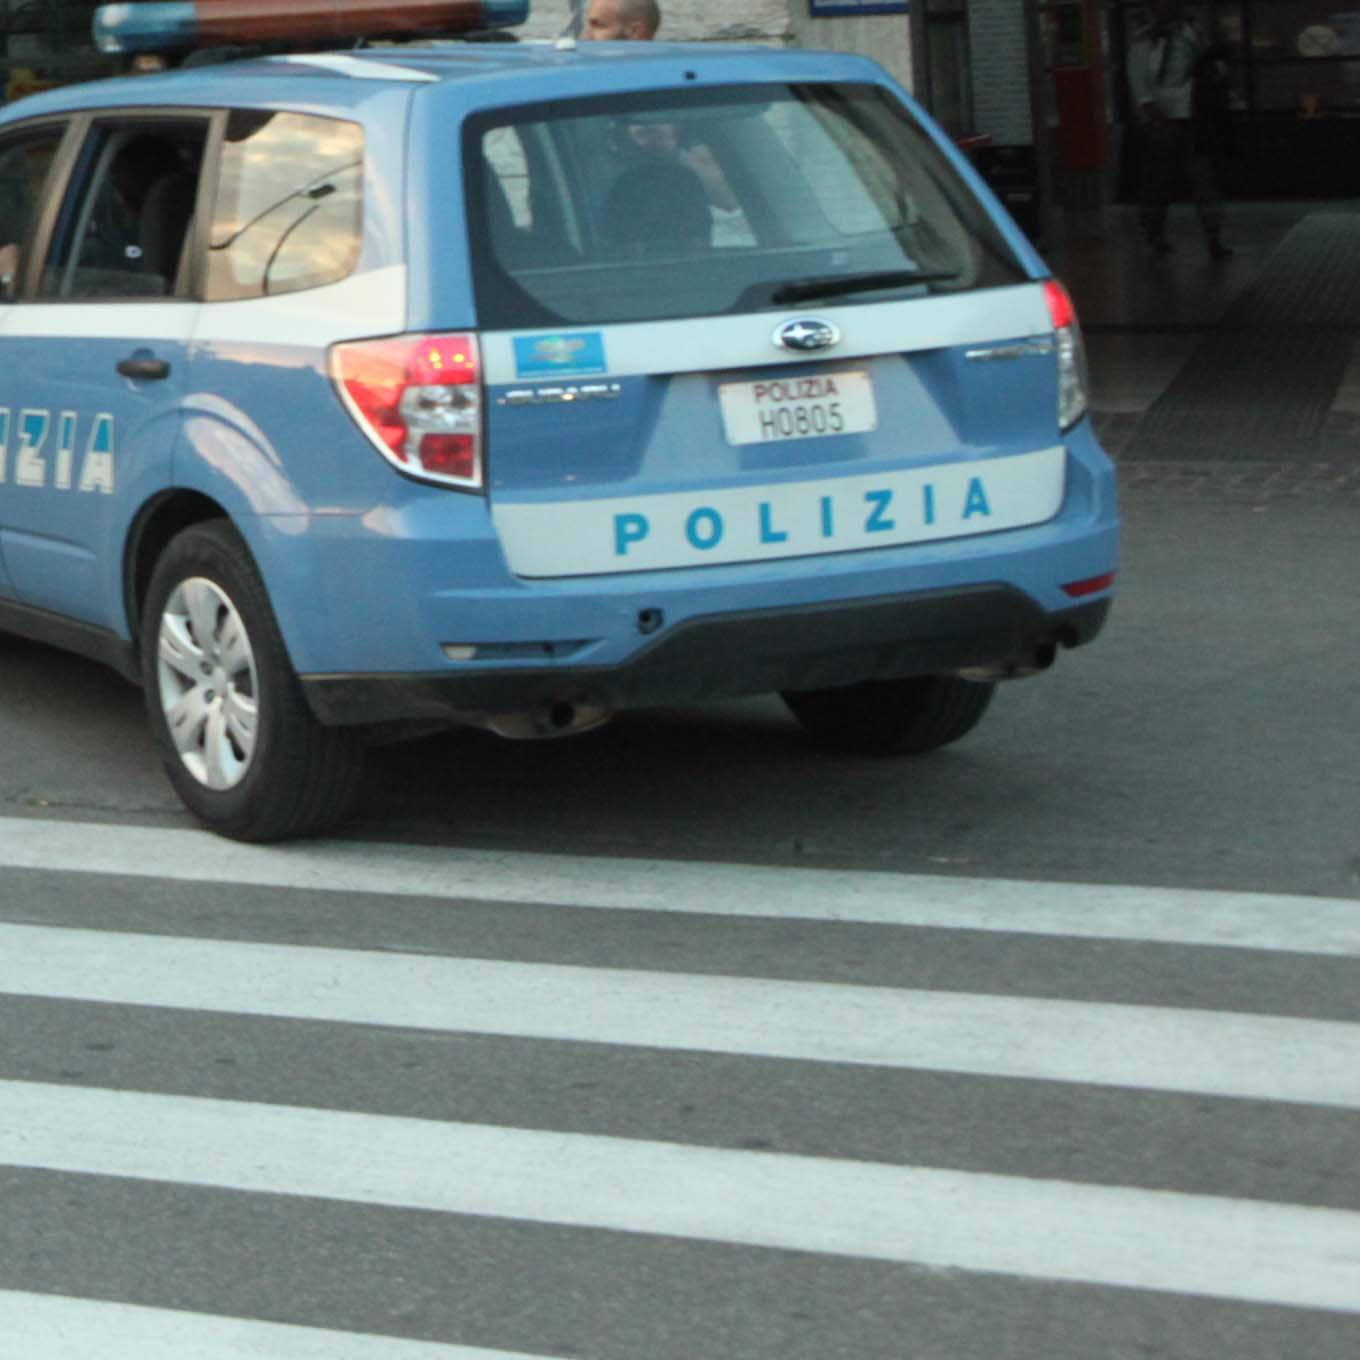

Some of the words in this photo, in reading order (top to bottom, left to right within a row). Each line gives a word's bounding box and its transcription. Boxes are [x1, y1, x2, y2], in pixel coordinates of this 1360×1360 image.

[754, 378, 838, 405] POLIZIA
[758, 402, 845, 439] H0805
[613, 476, 991, 557] POLIZIA
